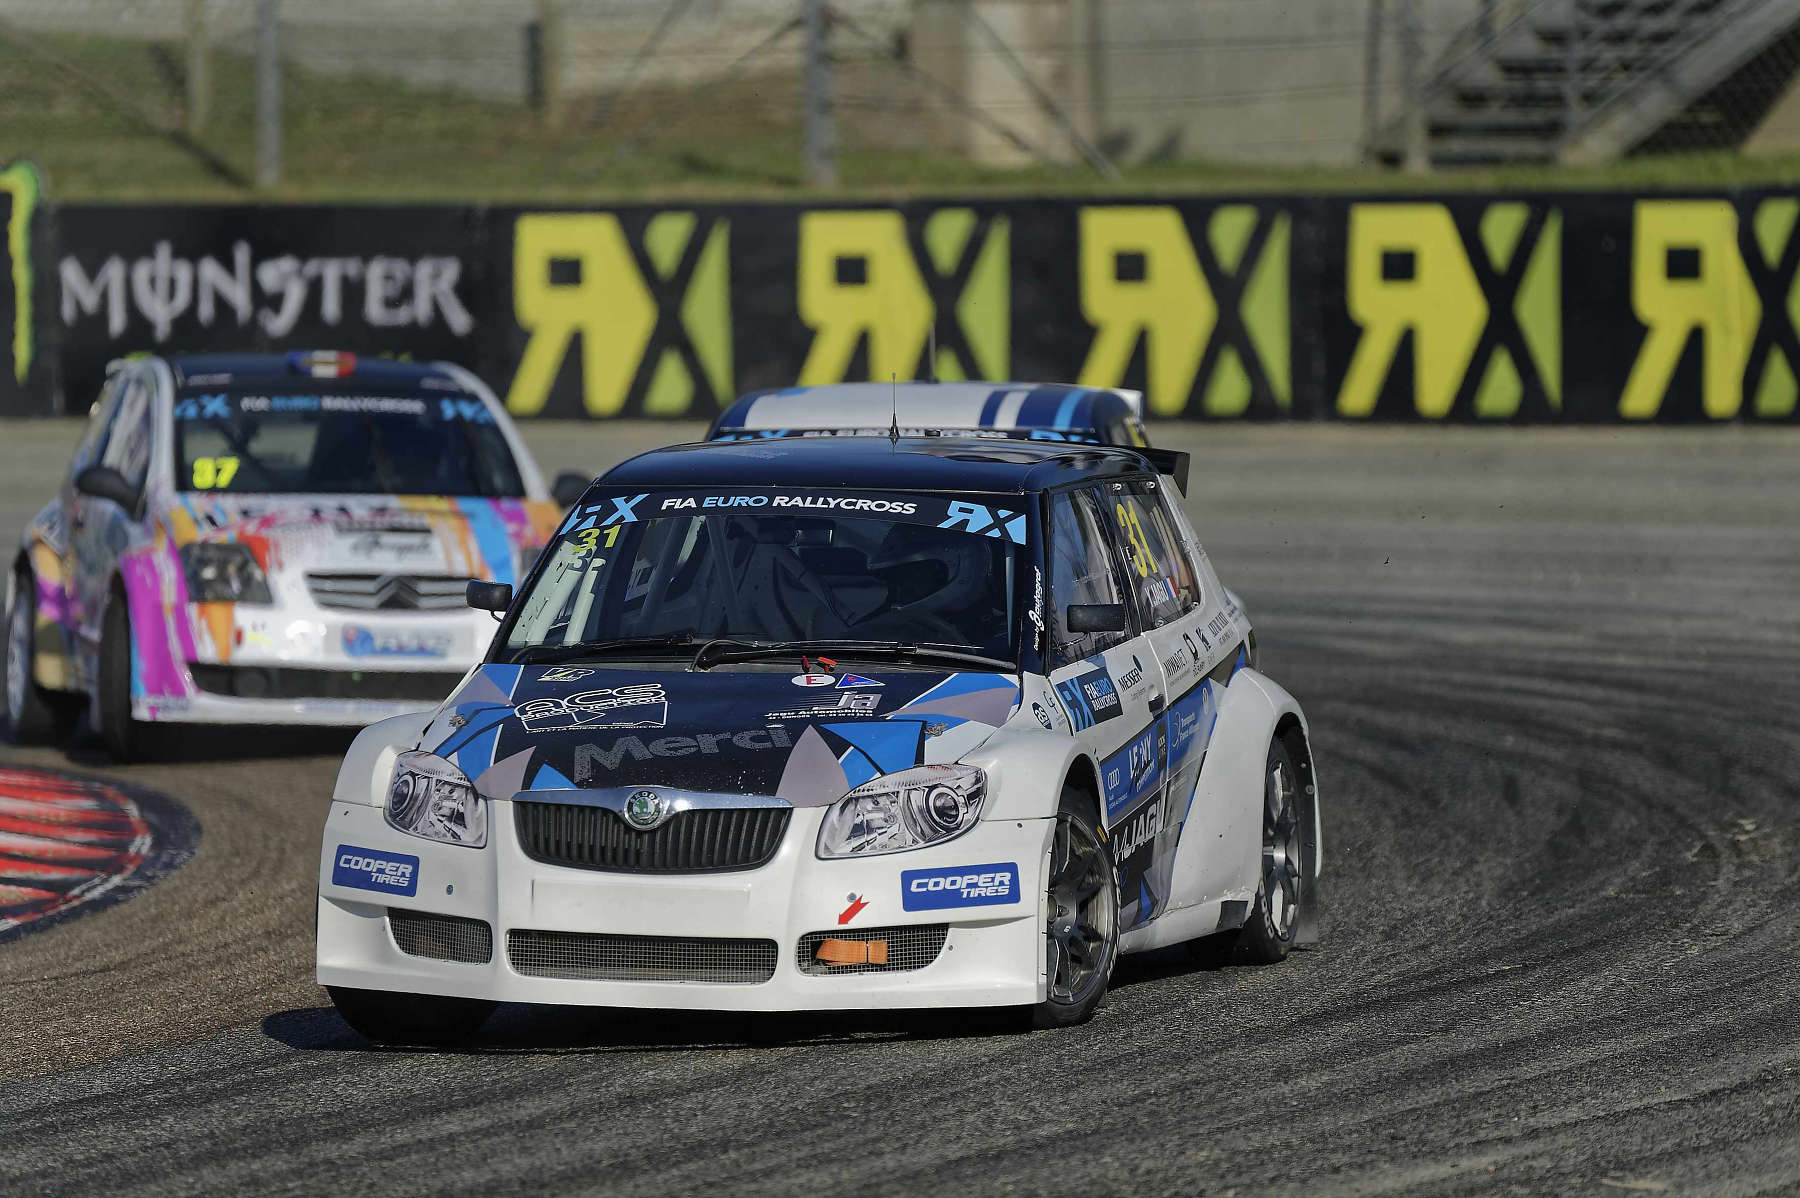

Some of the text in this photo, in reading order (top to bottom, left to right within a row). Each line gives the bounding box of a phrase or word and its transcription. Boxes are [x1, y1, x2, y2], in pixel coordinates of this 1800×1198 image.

[59, 239, 474, 343] MONSTER
[661, 496, 918, 515] FIA EURO RALLYCROSS
[572, 525, 622, 553] 31
[1116, 501, 1158, 578] 31
[805, 675, 825, 686] E
[1118, 667, 1142, 692] MESSER
[574, 724, 793, 784] Merci
[339, 854, 413, 878] COOPER
[370, 871, 410, 887] TIRES
[910, 871, 1012, 893] COOPER
[960, 886, 1010, 899] TIRES
